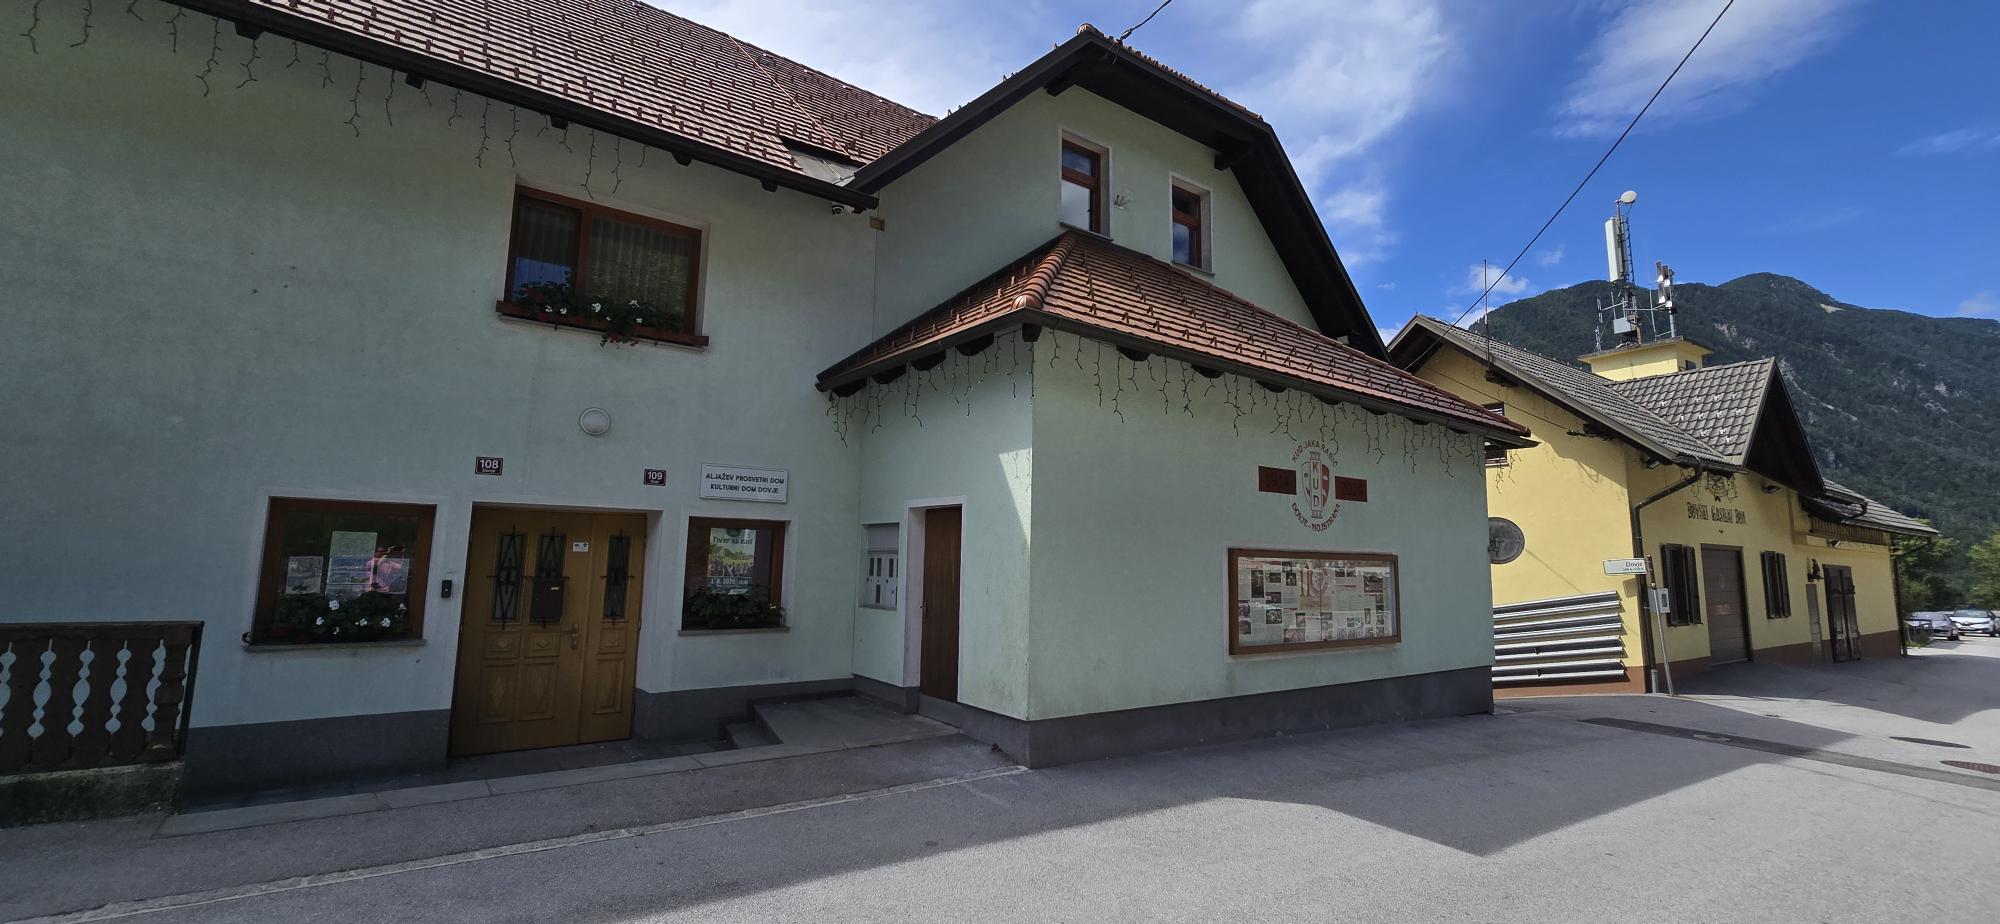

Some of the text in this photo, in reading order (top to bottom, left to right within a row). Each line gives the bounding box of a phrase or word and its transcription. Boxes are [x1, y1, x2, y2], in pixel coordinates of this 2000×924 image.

[1304, 440, 1320, 449] JAKA
[479, 459, 499, 469] 108
[647, 471, 663, 480] 109
[705, 472, 735, 481] ALJAŽEV
[735, 475, 769, 484] PROSVETNI
[710, 483, 740, 491] KULTURNI
[757, 486, 779, 494] DOVJE
